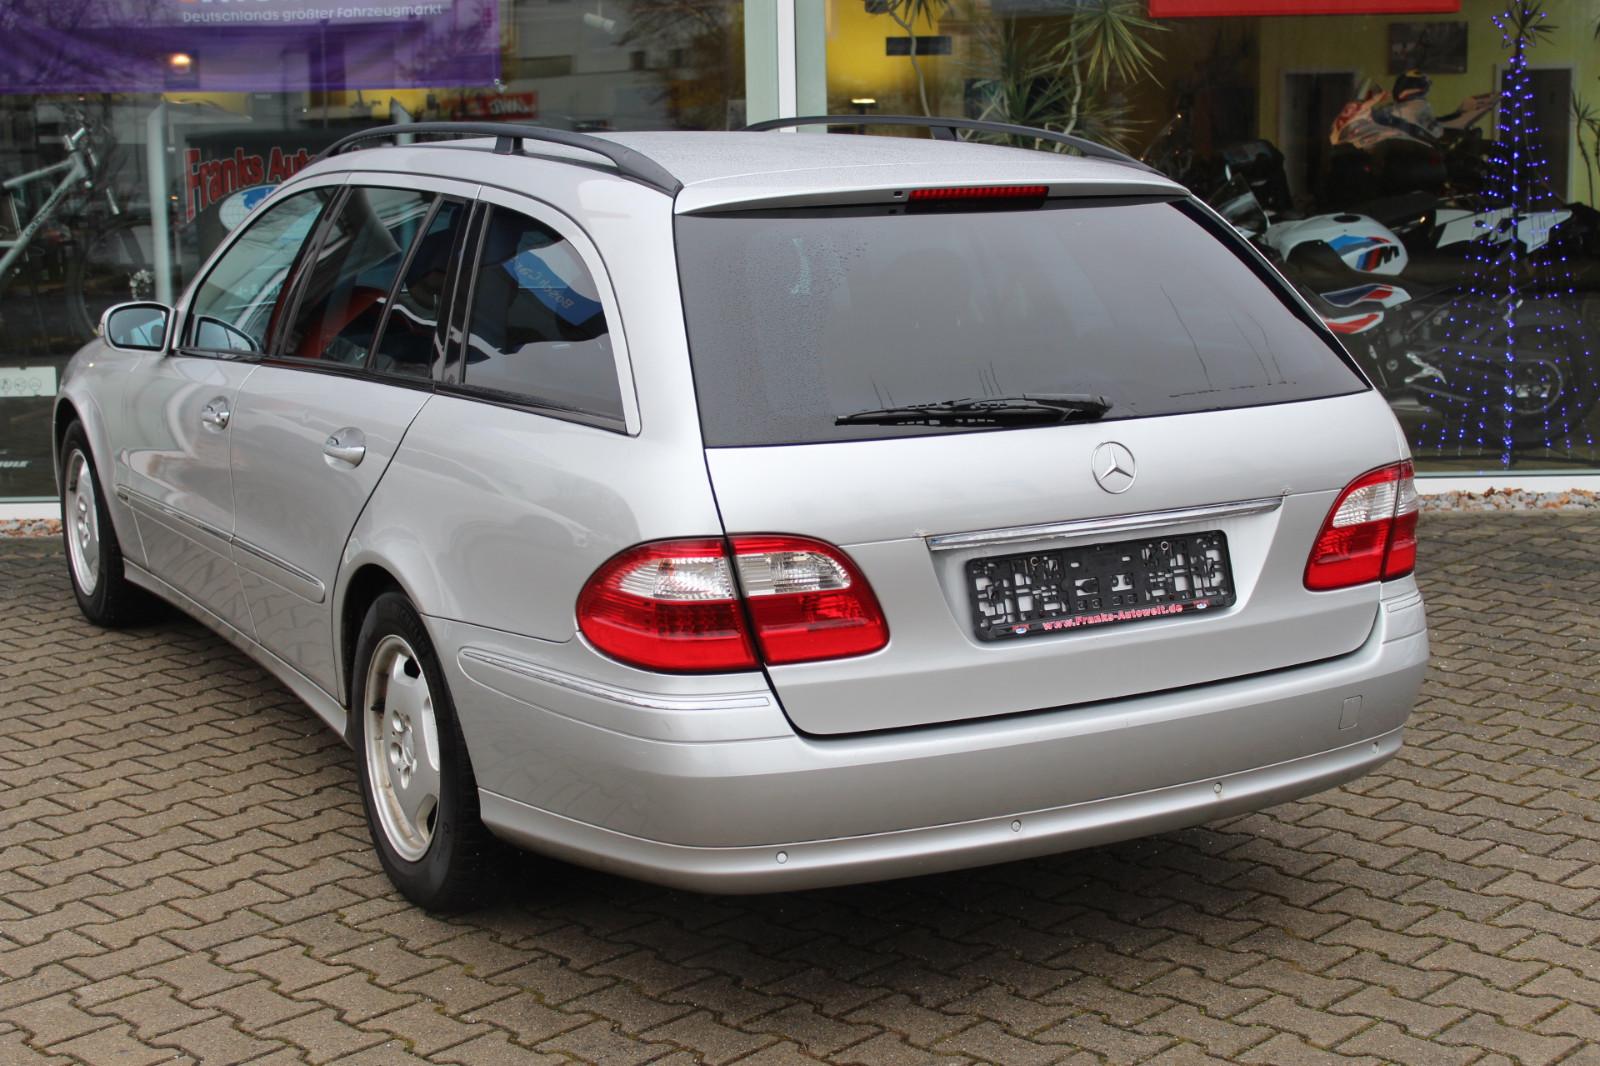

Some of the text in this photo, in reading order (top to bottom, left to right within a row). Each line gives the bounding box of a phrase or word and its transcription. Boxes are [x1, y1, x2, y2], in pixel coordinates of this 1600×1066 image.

[183, 10, 279, 22] Deutschlands
[336, 5, 443, 19] Fahrzeugmarkt
[184, 147, 264, 223] Franks
[1042, 603, 1184, 630] www.Franks-Autowelt.de
